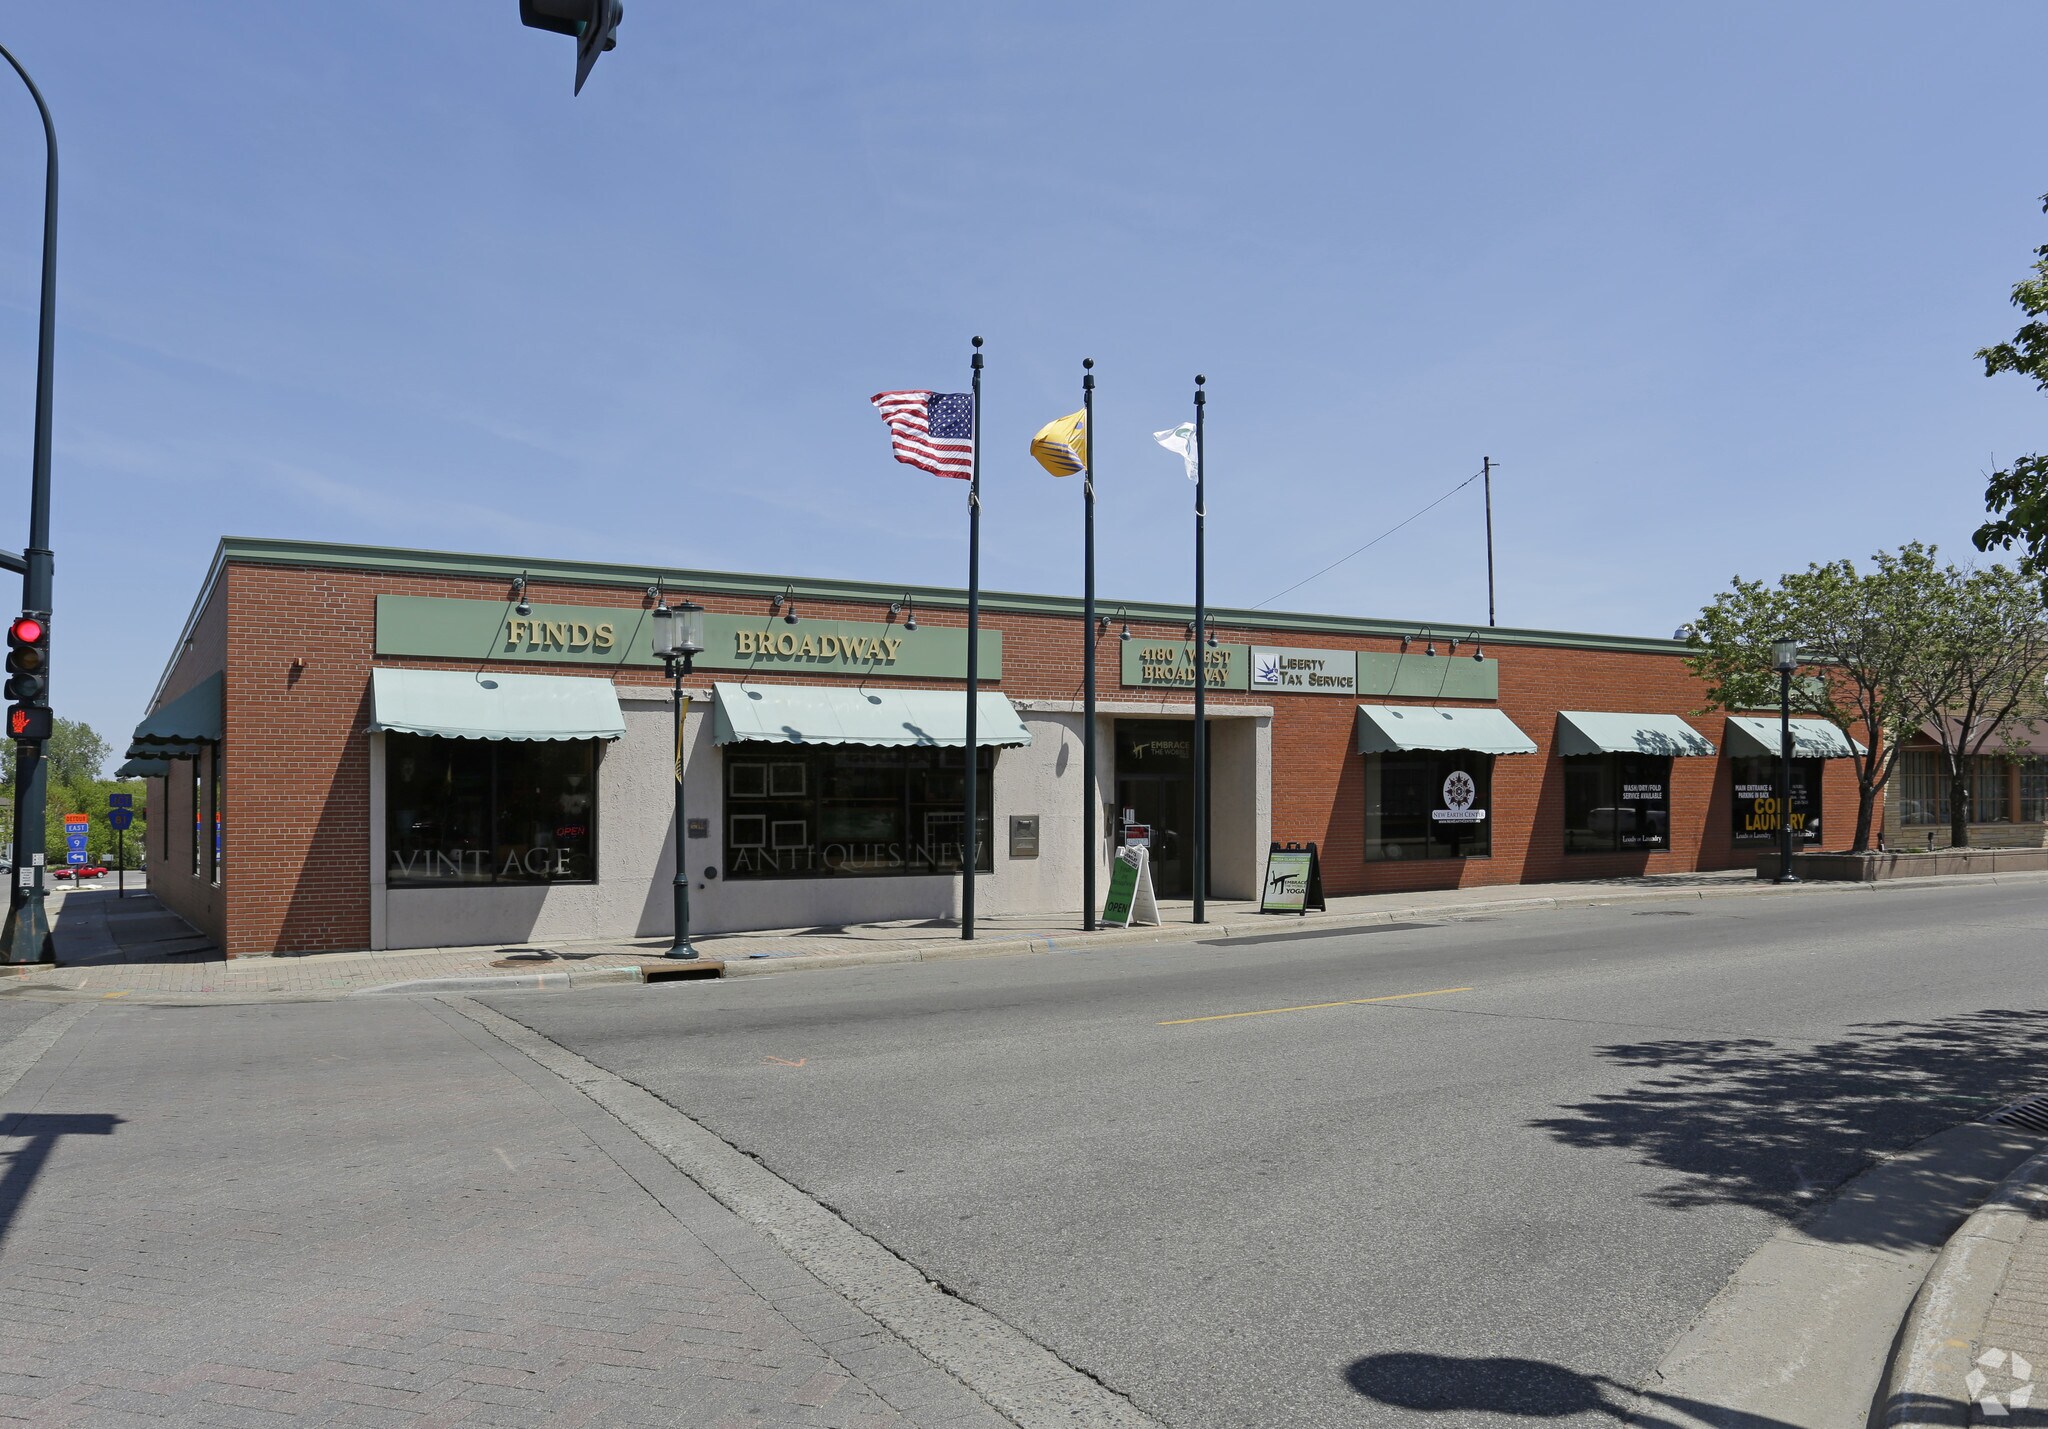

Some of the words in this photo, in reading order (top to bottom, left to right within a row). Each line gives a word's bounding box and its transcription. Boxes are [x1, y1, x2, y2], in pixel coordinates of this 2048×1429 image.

[506, 619, 615, 648] FINDS
[736, 631, 902, 661] BROADWAY
[1141, 647, 1174, 661] 4180
[1186, 648, 1231, 664] WEST
[1279, 655, 1326, 672] LIBERTY
[1279, 671, 1303, 686] TAX
[1308, 672, 1354, 688] SERVICE
[1623, 792, 1640, 800] SERVICE
[1640, 792, 1662, 800] AVAILABLE
[1745, 813, 1806, 831] LAUNRY
[556, 825, 586, 838] OPEN
[73, 839, 81, 848] 9
[914, 840, 983, 867] NEW
[1108, 902, 1128, 914] OPEN
